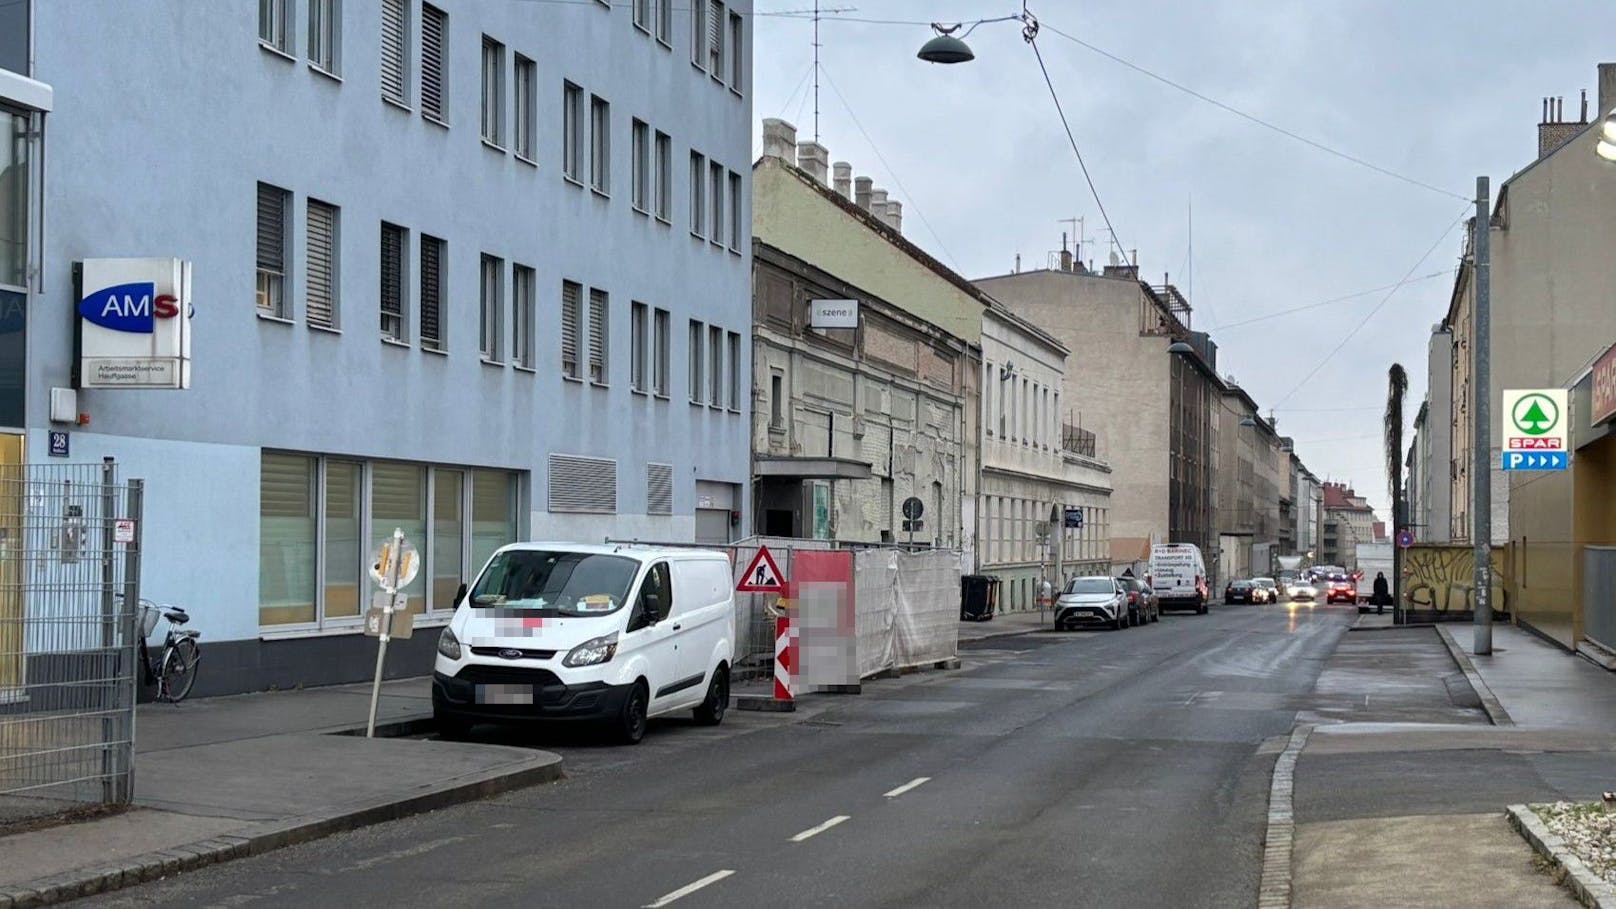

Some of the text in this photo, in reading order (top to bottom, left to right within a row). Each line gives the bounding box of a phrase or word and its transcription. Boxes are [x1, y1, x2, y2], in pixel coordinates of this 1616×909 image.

[101, 294, 178, 319] AMS
[822, 309, 847, 317] szene
[53, 433, 66, 448] 28
[1510, 439, 1559, 448] SPAR
[1510, 453, 1524, 468] P
